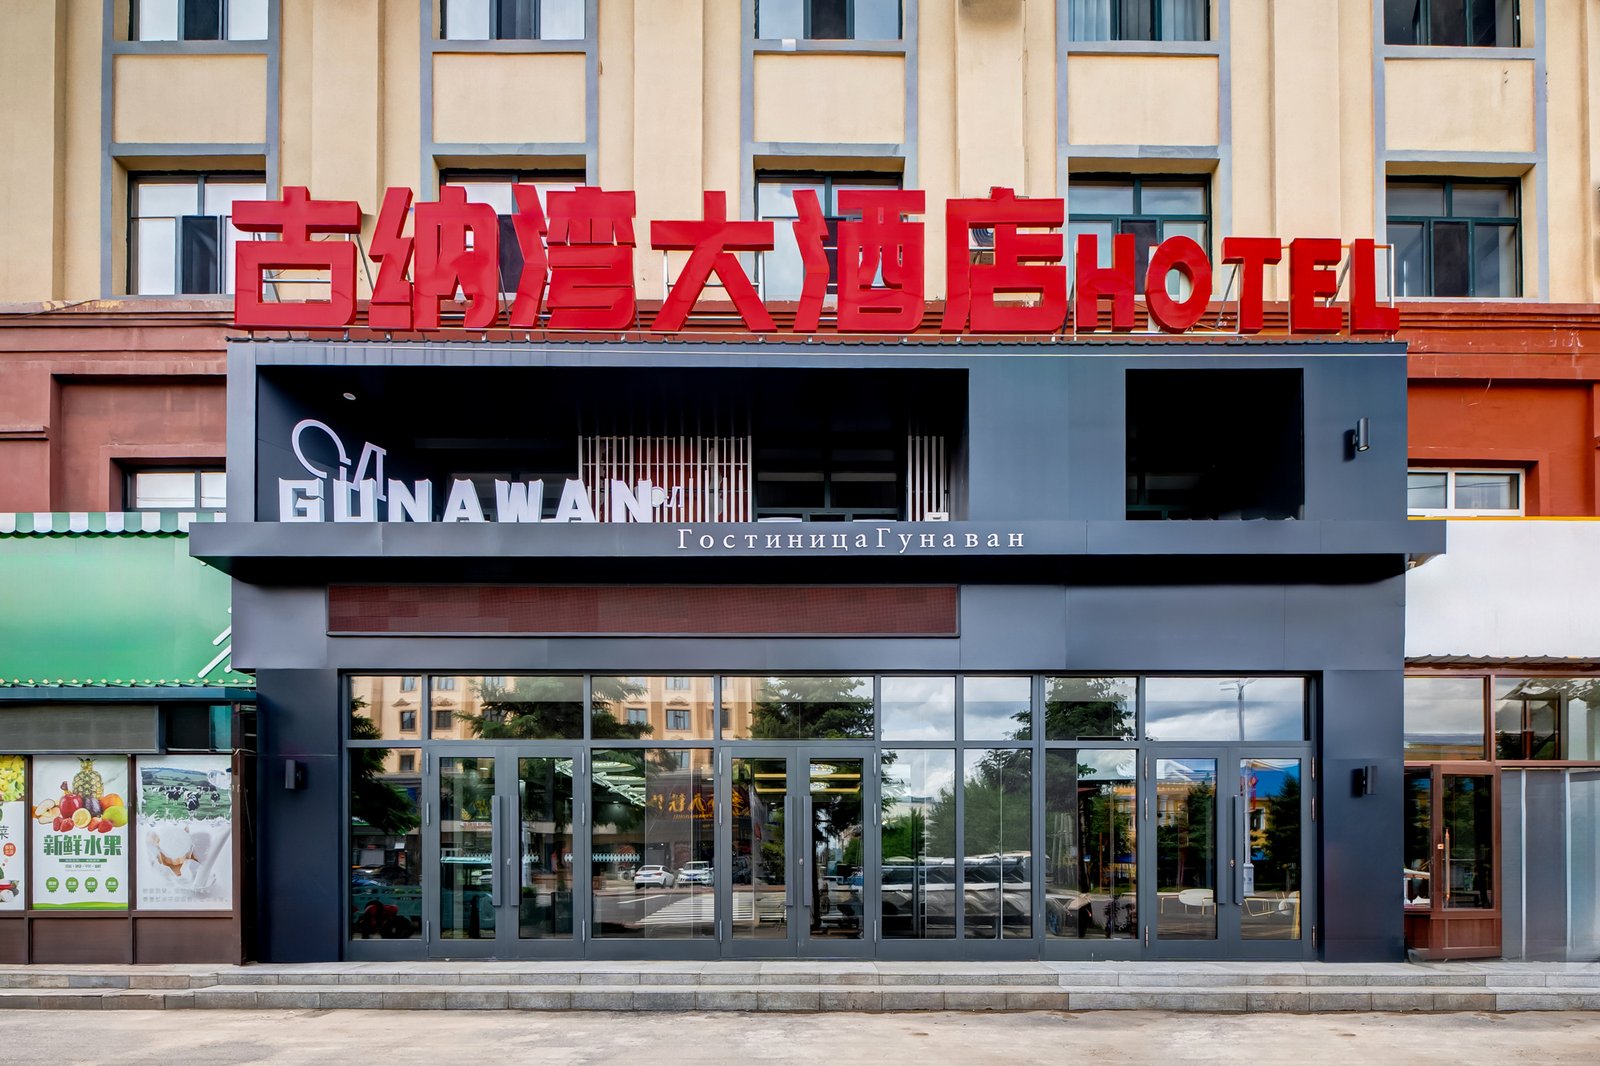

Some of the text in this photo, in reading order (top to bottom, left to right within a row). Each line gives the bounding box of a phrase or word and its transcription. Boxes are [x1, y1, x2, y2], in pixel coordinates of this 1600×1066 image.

[231, 185, 1401, 335] 古纳湾大酒店 HOTEL
[278, 478, 654, 524] GUNAWAN
[43, 834, 122, 856] 新鲜水果
